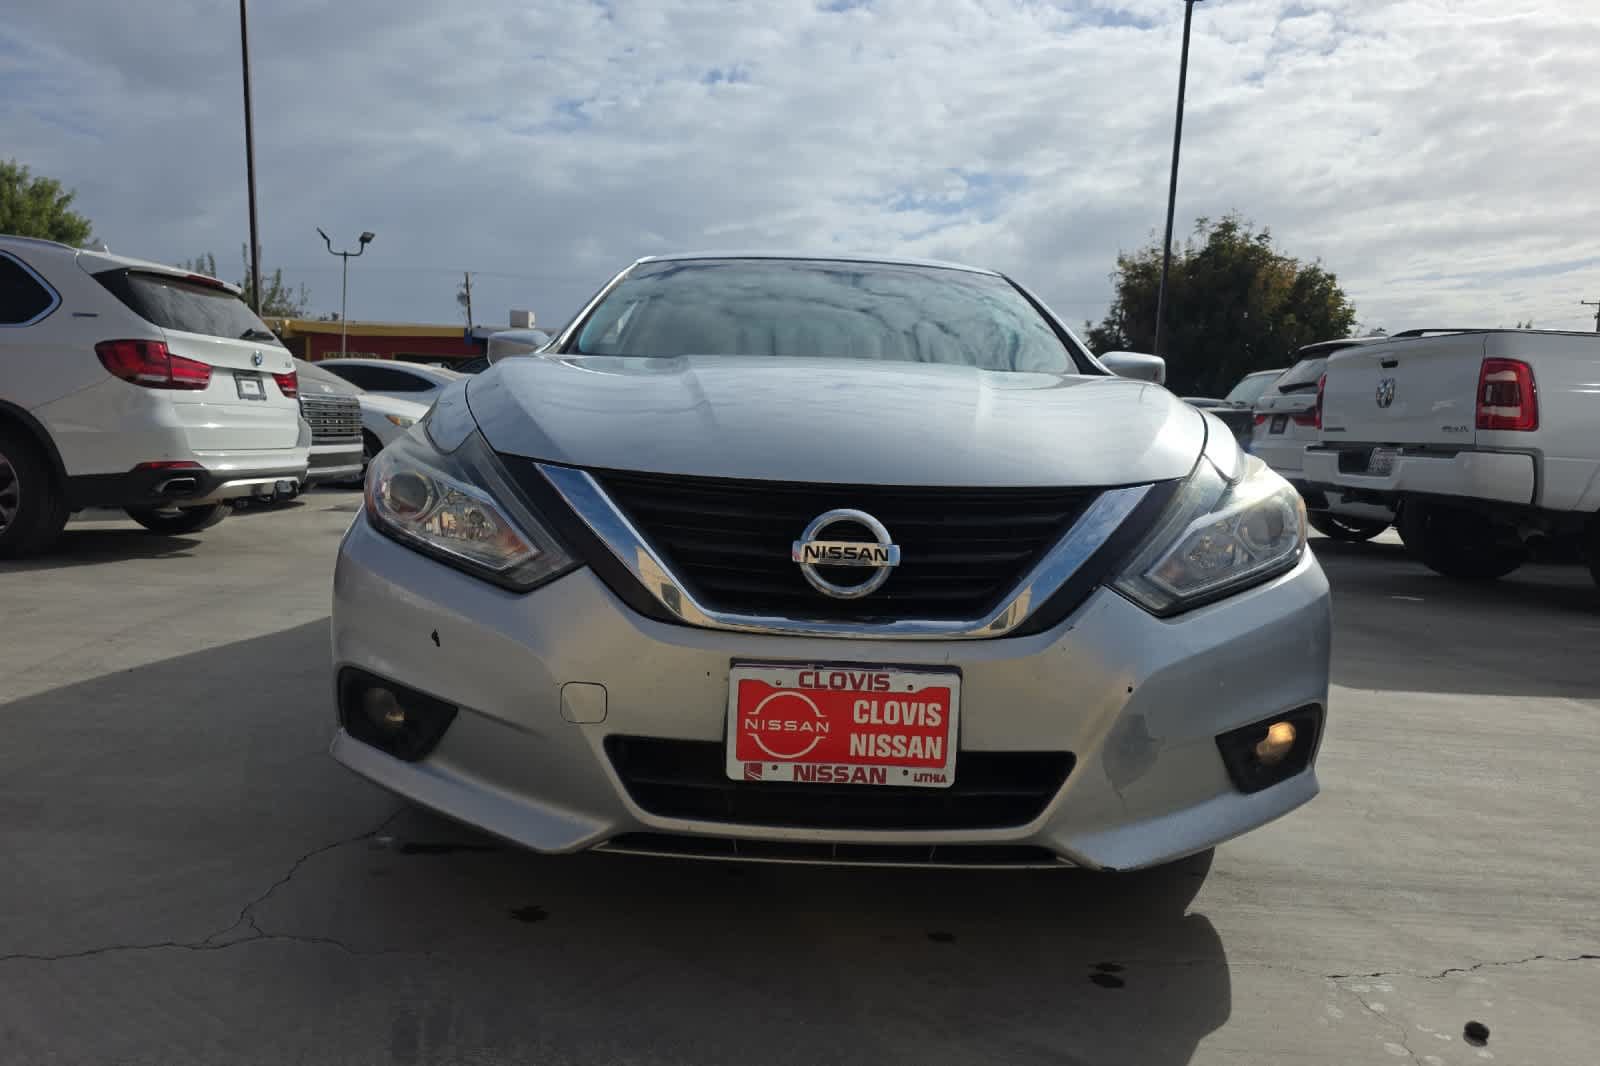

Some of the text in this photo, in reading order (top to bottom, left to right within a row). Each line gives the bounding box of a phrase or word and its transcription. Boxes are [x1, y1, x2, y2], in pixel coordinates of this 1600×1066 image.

[804, 545, 889, 562] NISSAN
[798, 671, 891, 691] CLOVIS
[853, 700, 942, 727] CLOVIS
[744, 718, 830, 734] NISSAN
[850, 733, 942, 760] NISSAN
[793, 764, 887, 785] NISSAN
[913, 772, 947, 783] LITHIA
